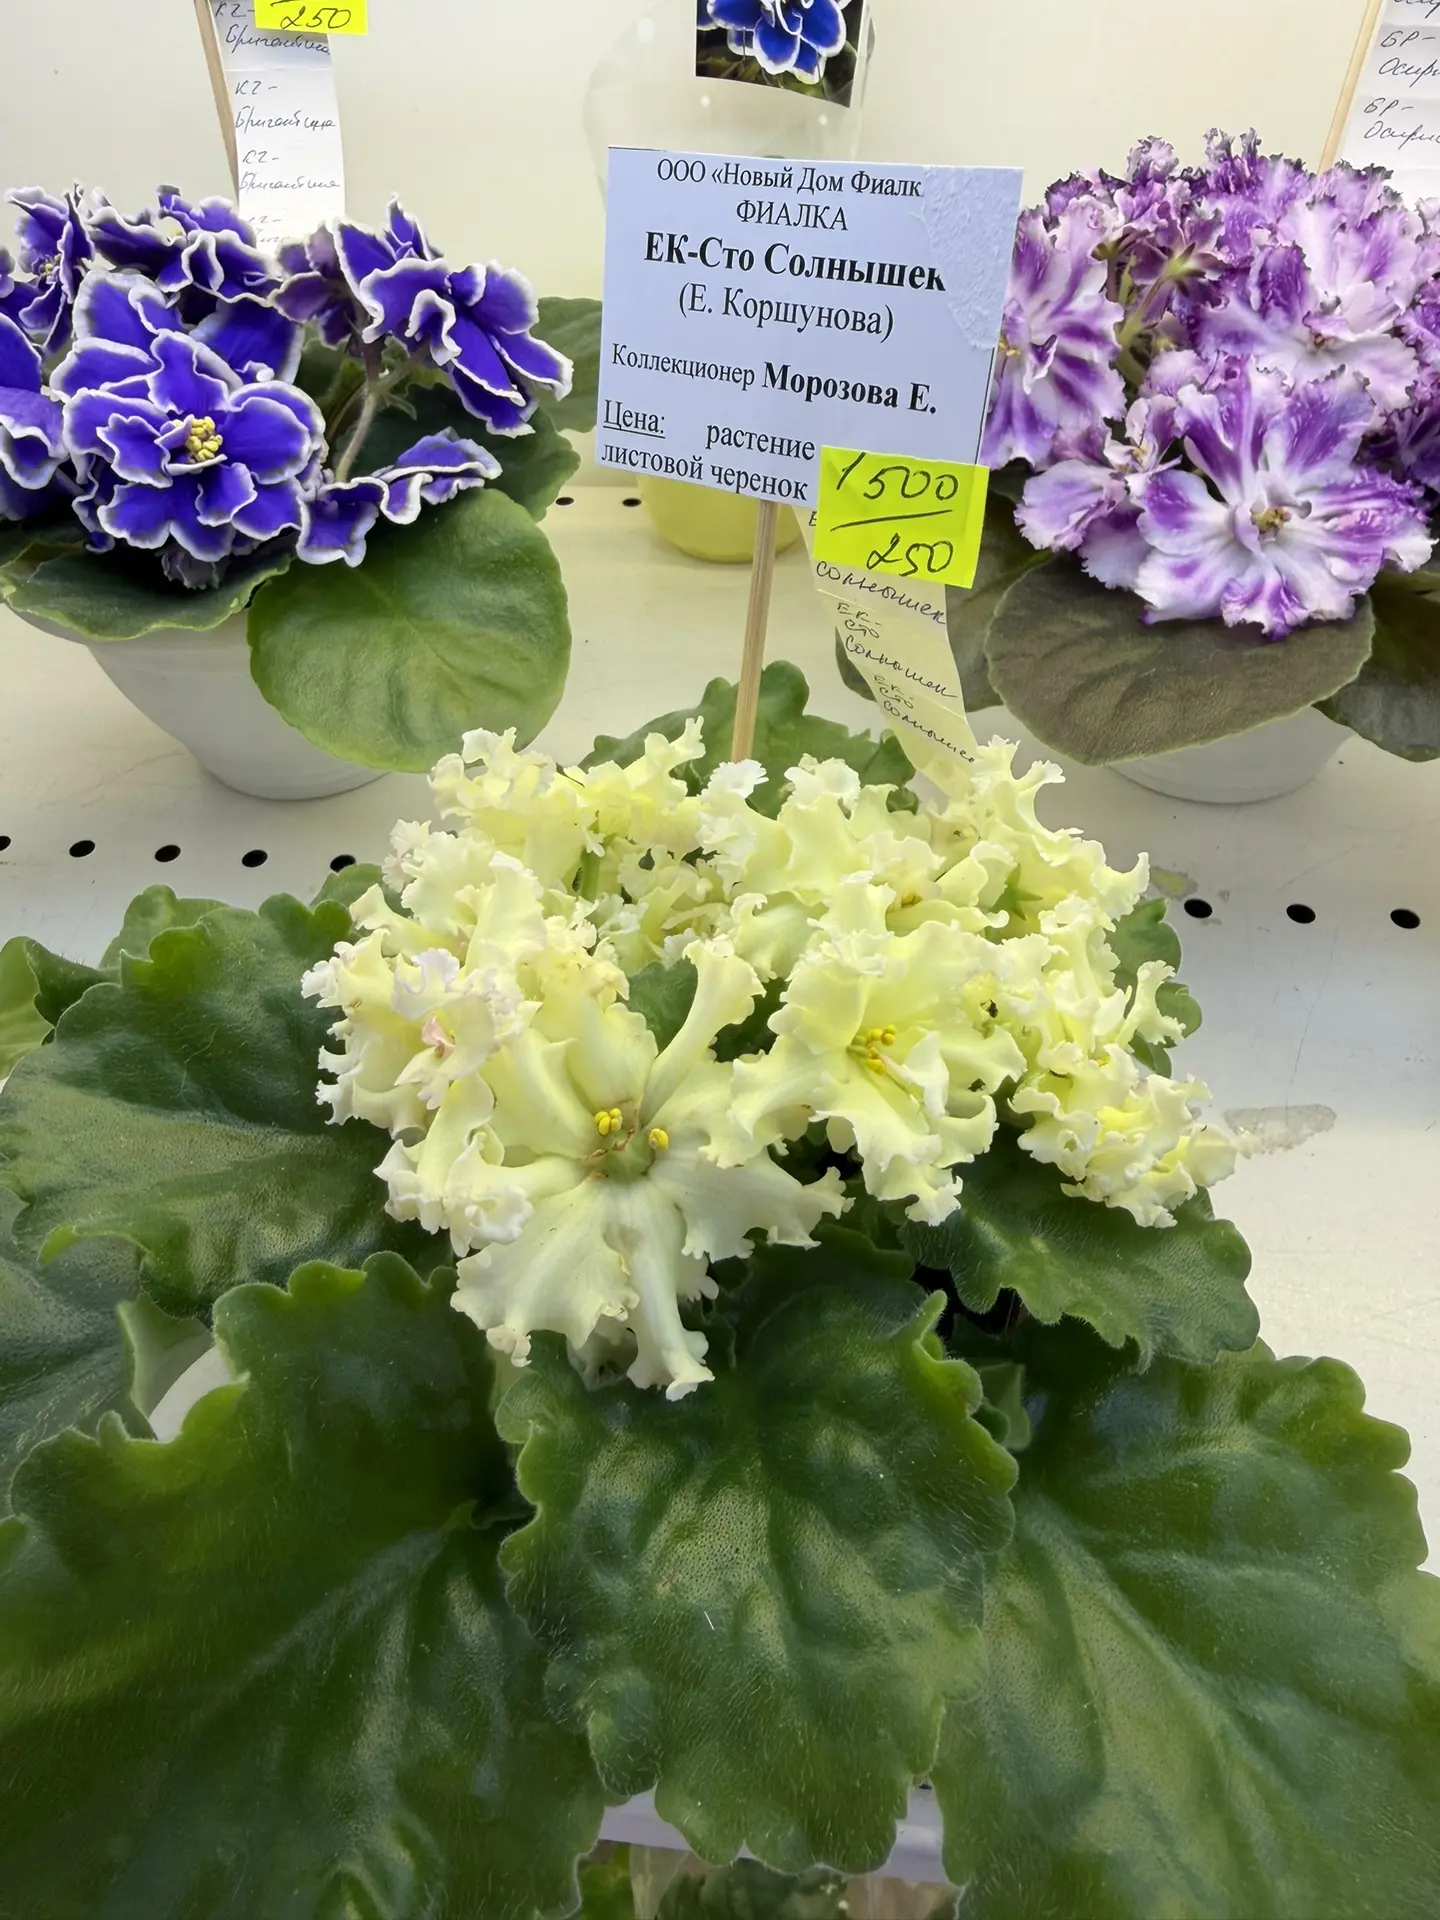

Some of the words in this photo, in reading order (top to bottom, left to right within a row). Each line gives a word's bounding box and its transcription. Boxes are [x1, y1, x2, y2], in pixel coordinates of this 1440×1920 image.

[280, 5, 351, 29] 250
[657, 158, 706, 183] ООО
[711, 162, 794, 189] «Новый
[796, 167, 844, 195] Дом
[736, 199, 849, 232] ФИАЛКА
[643, 231, 755, 272] ЕК-Сто
[764, 242, 947, 292] Солнышек
[678, 281, 713, 318] (Е.
[721, 286, 894, 344] Коршунова)
[611, 342, 756, 392] Коллекционер
[761, 361, 899, 409] Морозова
[906, 381, 937, 415] Е.
[602, 399, 666, 435] Цена:
[704, 424, 816, 461] растение
[601, 444, 704, 481] листовой
[710, 464, 809, 501] черенок
[835, 451, 959, 501] 1500
[866, 532, 954, 577] 250
